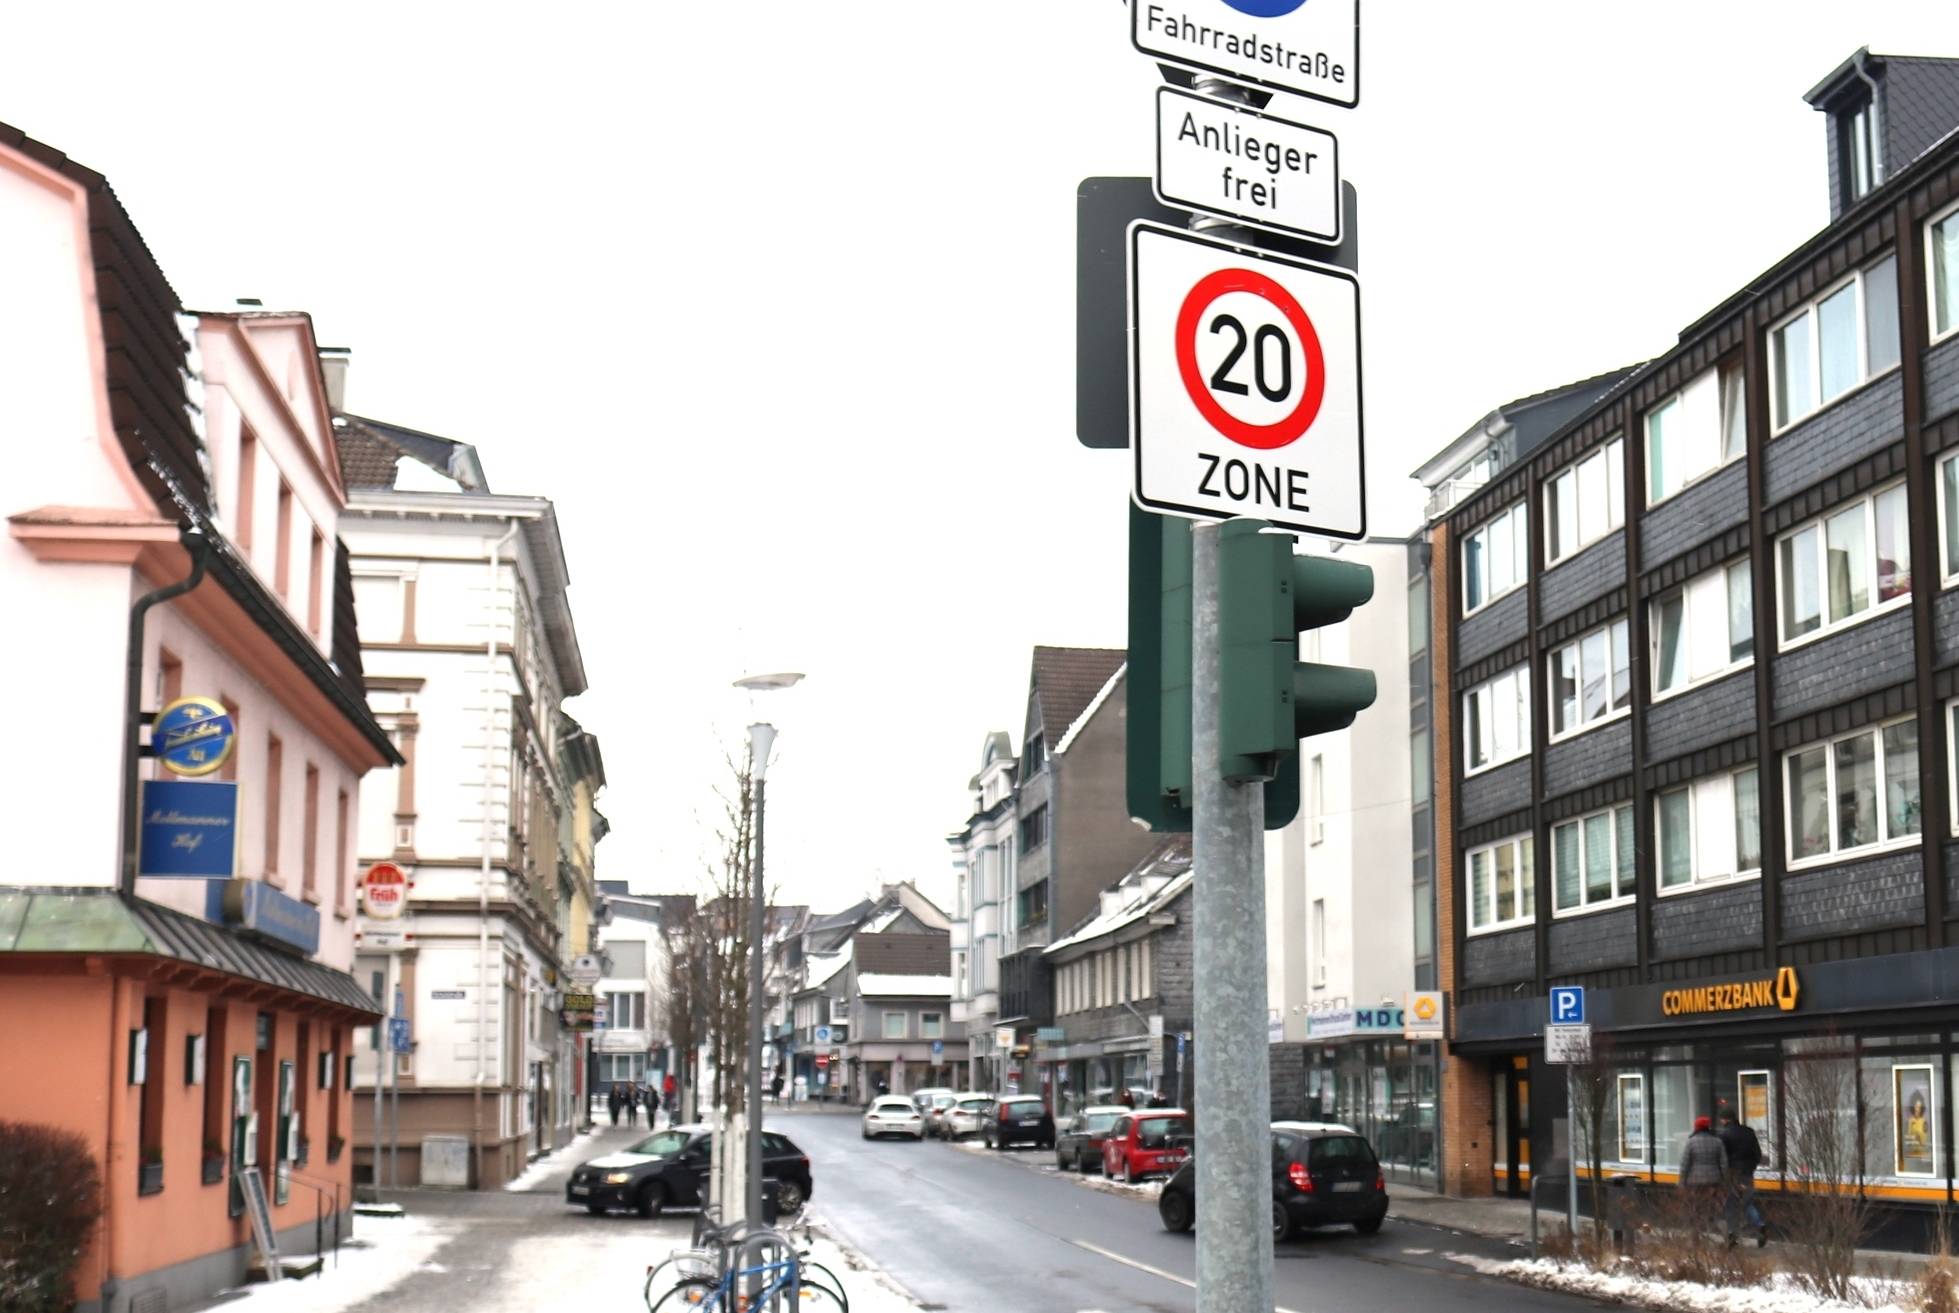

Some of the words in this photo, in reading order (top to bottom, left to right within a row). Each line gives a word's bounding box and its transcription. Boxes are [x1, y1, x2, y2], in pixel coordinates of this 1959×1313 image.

[1147, 4, 1346, 84] Fahrradstraße
[1177, 111, 1318, 175] Anlieger
[1222, 166, 1278, 210] frei
[1209, 313, 1292, 403] 20
[1197, 452, 1310, 513] ZONE
[370, 887, 398, 902] Früh
[1558, 991, 1577, 1020] P
[1662, 980, 1774, 1016] COMMERZBANK
